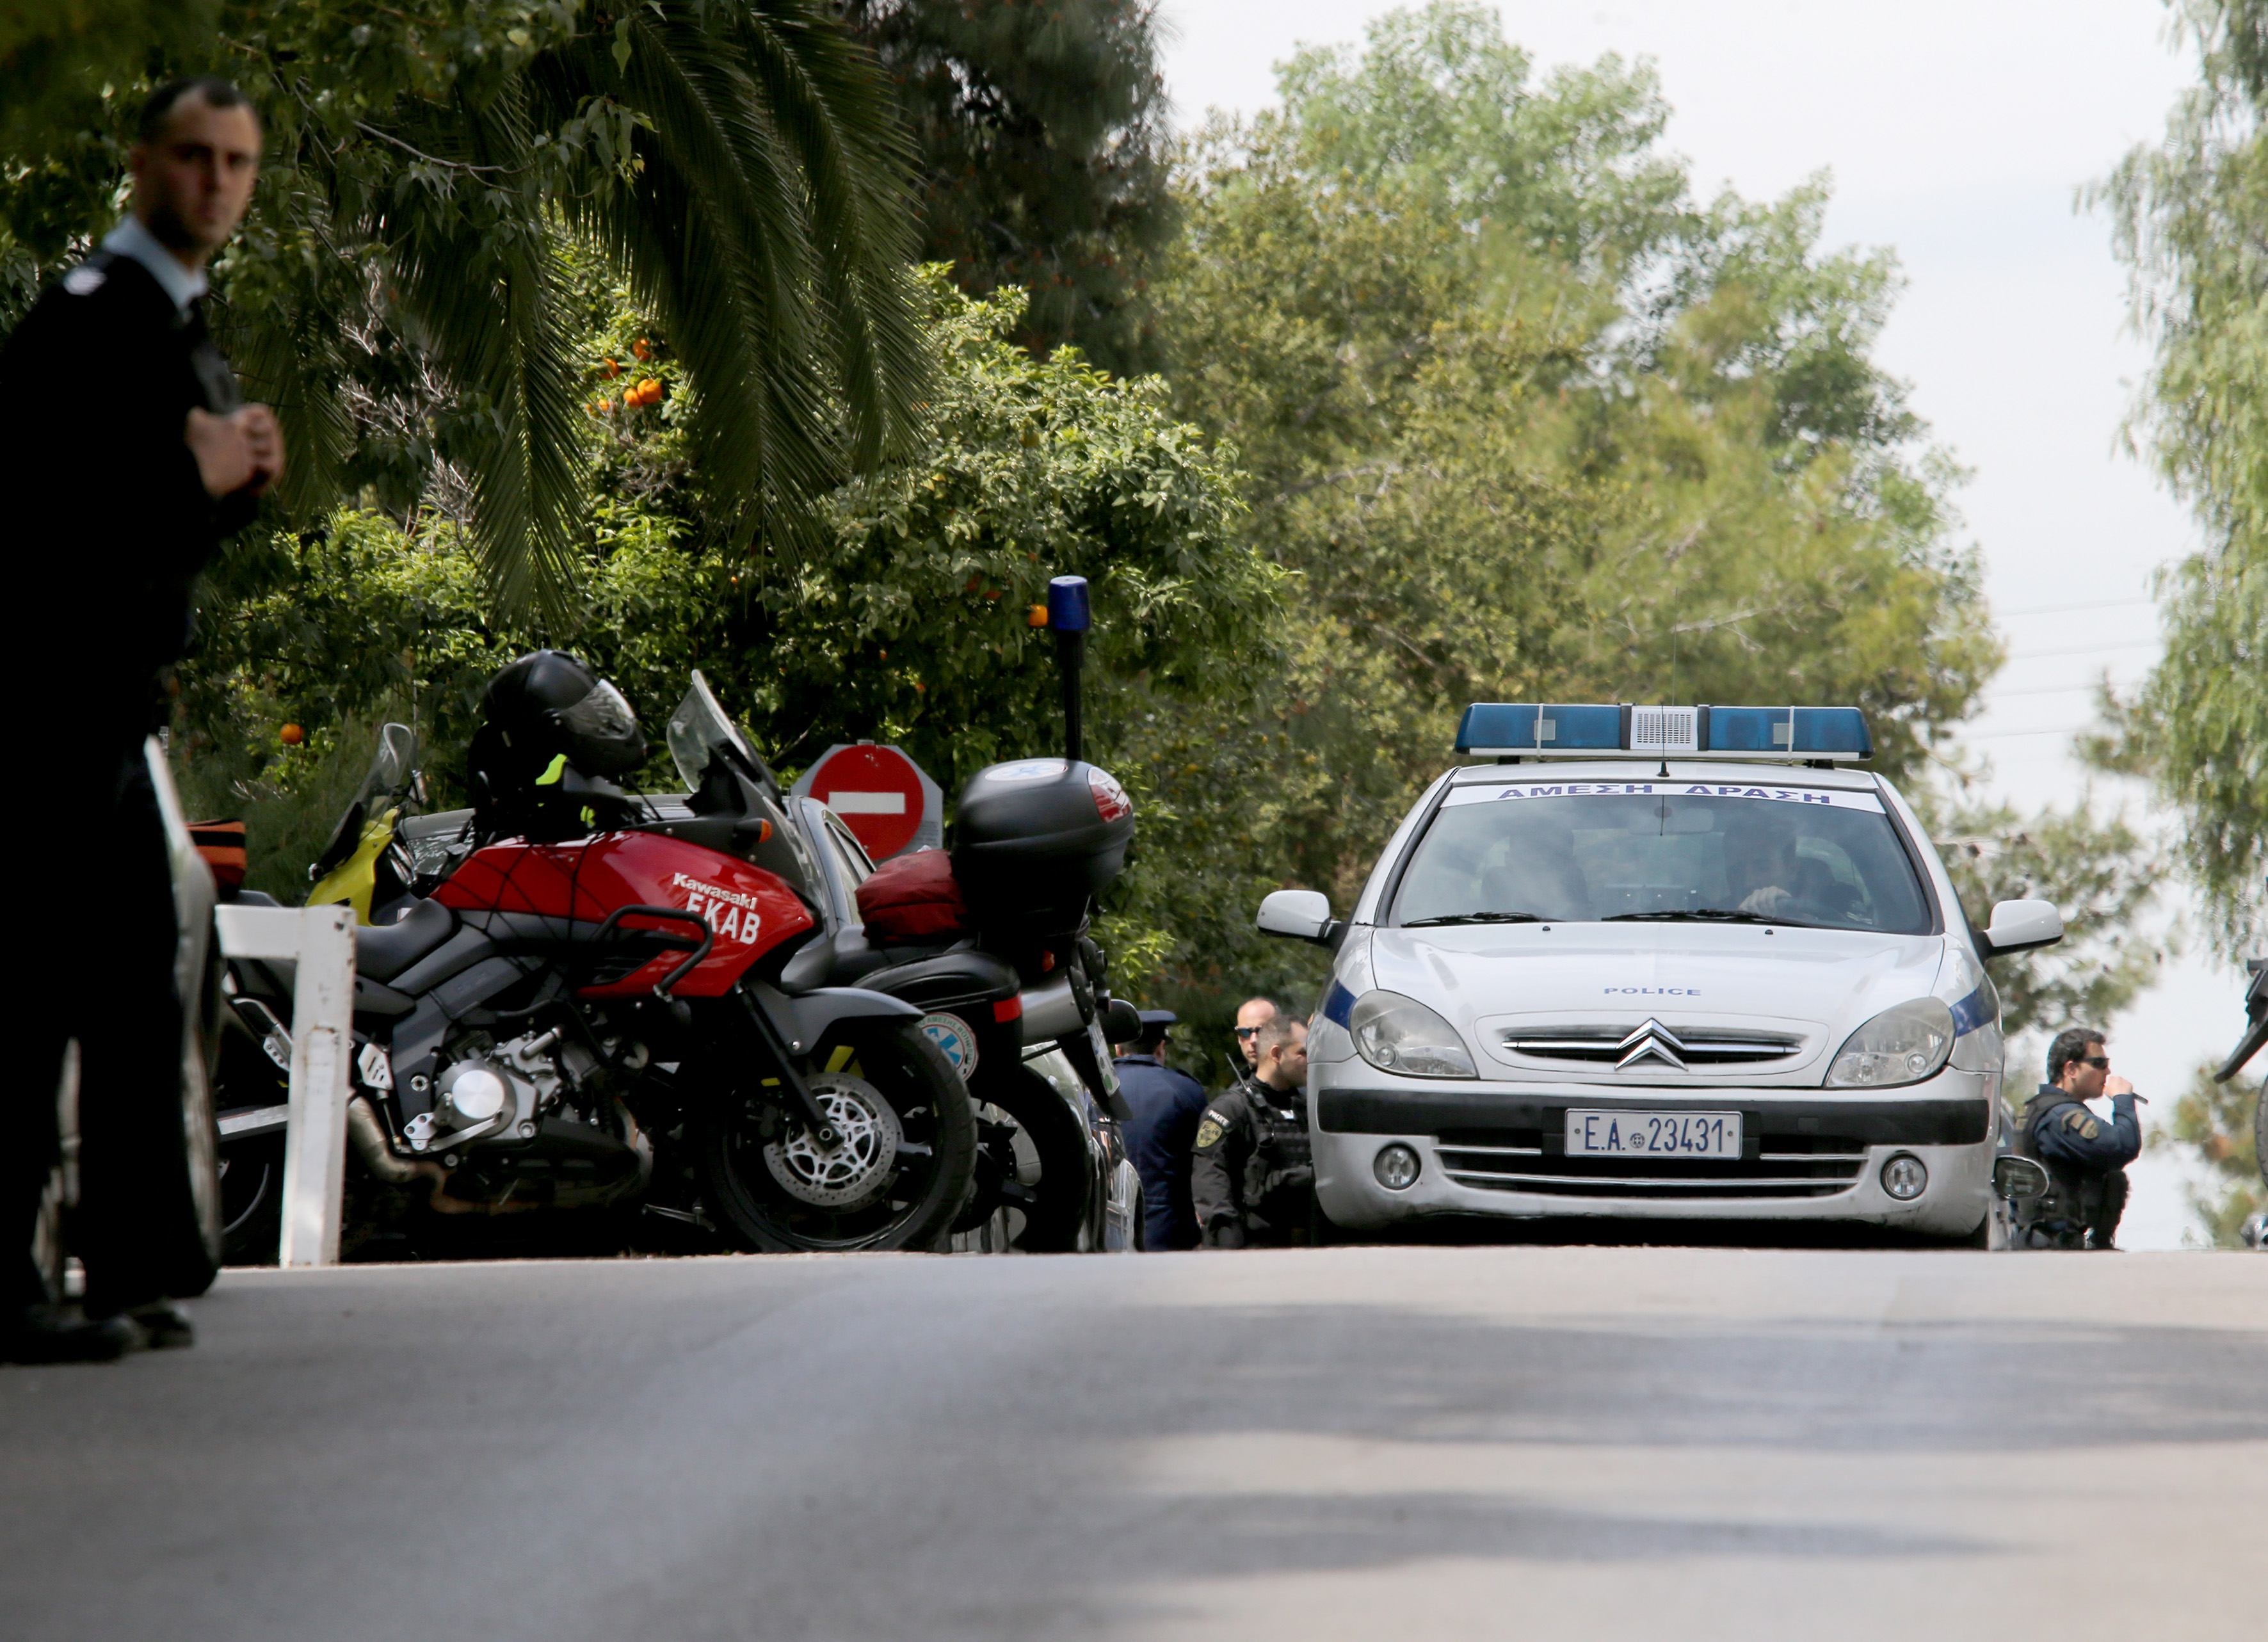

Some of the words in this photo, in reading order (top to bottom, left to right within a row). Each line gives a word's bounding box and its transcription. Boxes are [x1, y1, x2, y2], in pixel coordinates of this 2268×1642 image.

[1497, 785, 1652, 799] ΑΜΕΣΗ
[1685, 785, 1830, 803] ΔΡΑΣΗ
[673, 873, 758, 910] Kawasaki
[1604, 988, 1701, 996] POLICE
[1648, 1118, 1723, 1152] 23431
